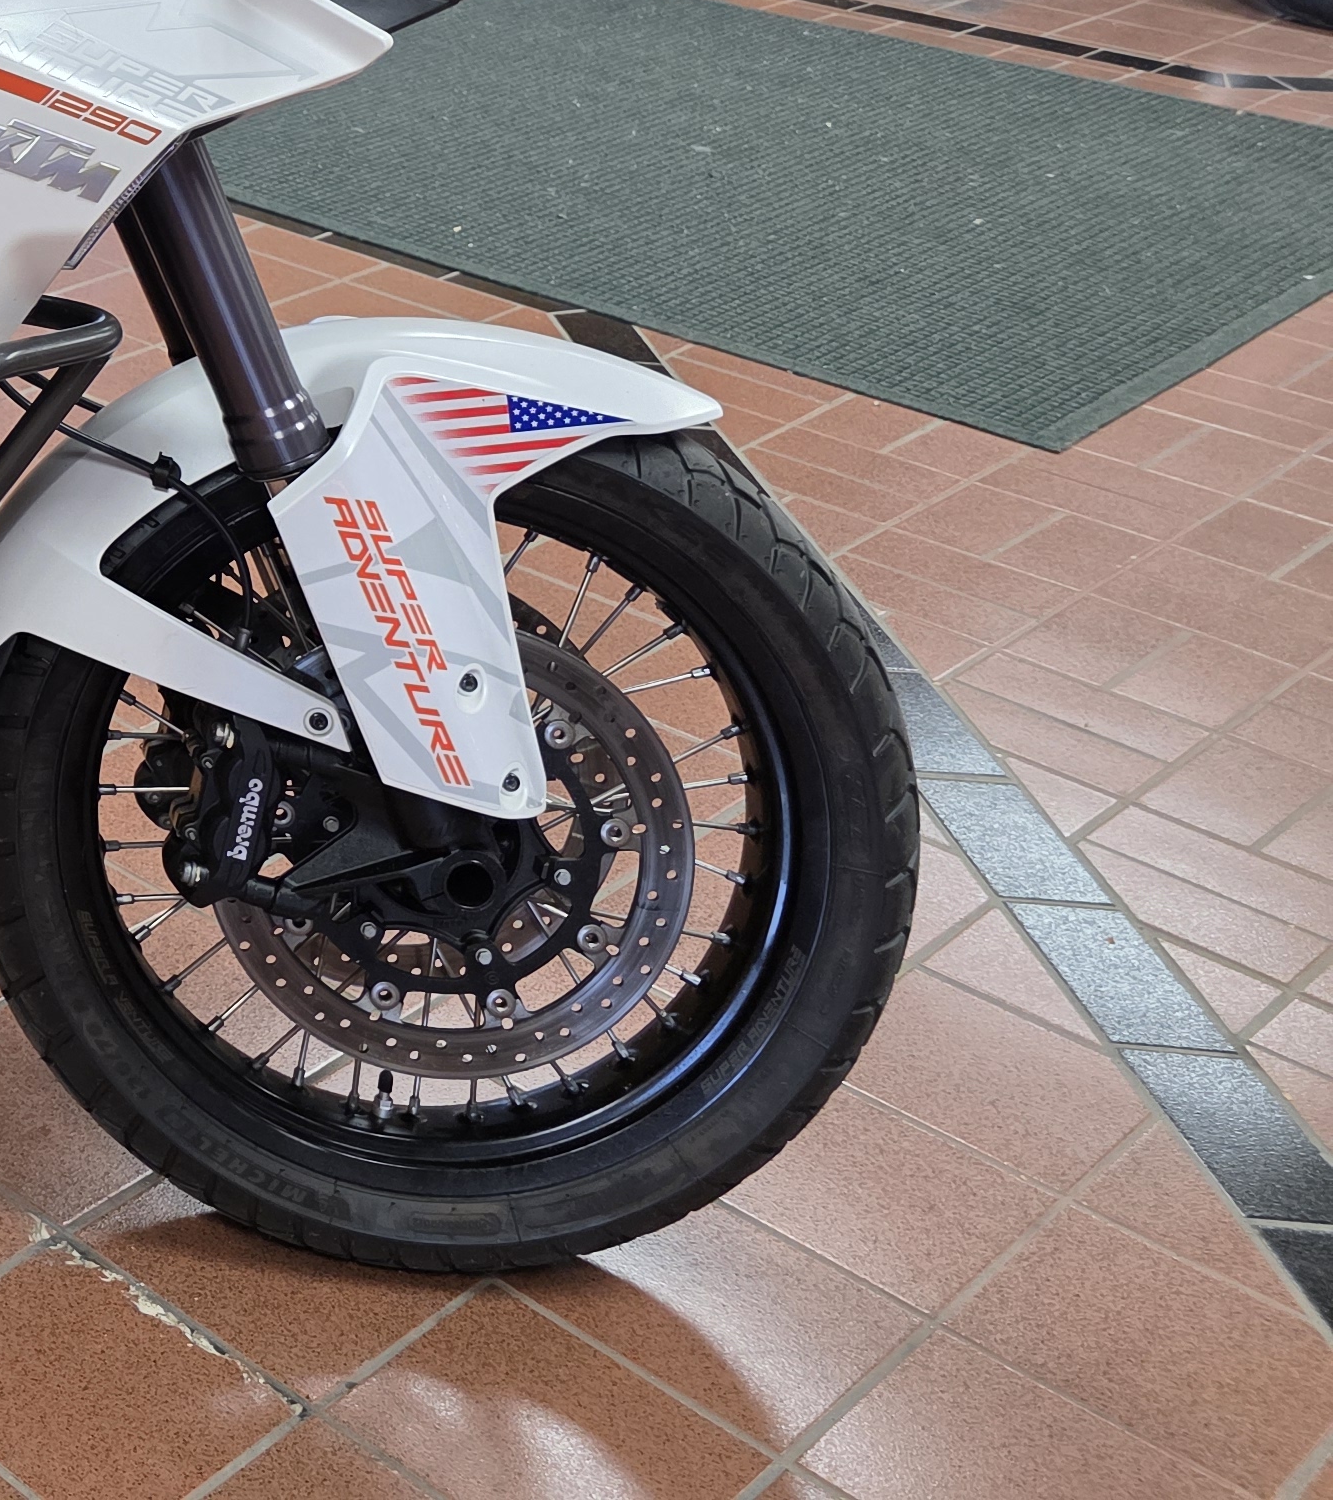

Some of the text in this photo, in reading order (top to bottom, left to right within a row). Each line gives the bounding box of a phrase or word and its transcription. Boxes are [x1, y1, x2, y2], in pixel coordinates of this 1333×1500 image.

[40, 89, 163, 146] 1290
[323, 496, 472, 787] ADVENTURE
[355, 499, 448, 671] SUPER
[226, 778, 264, 861] brembo
